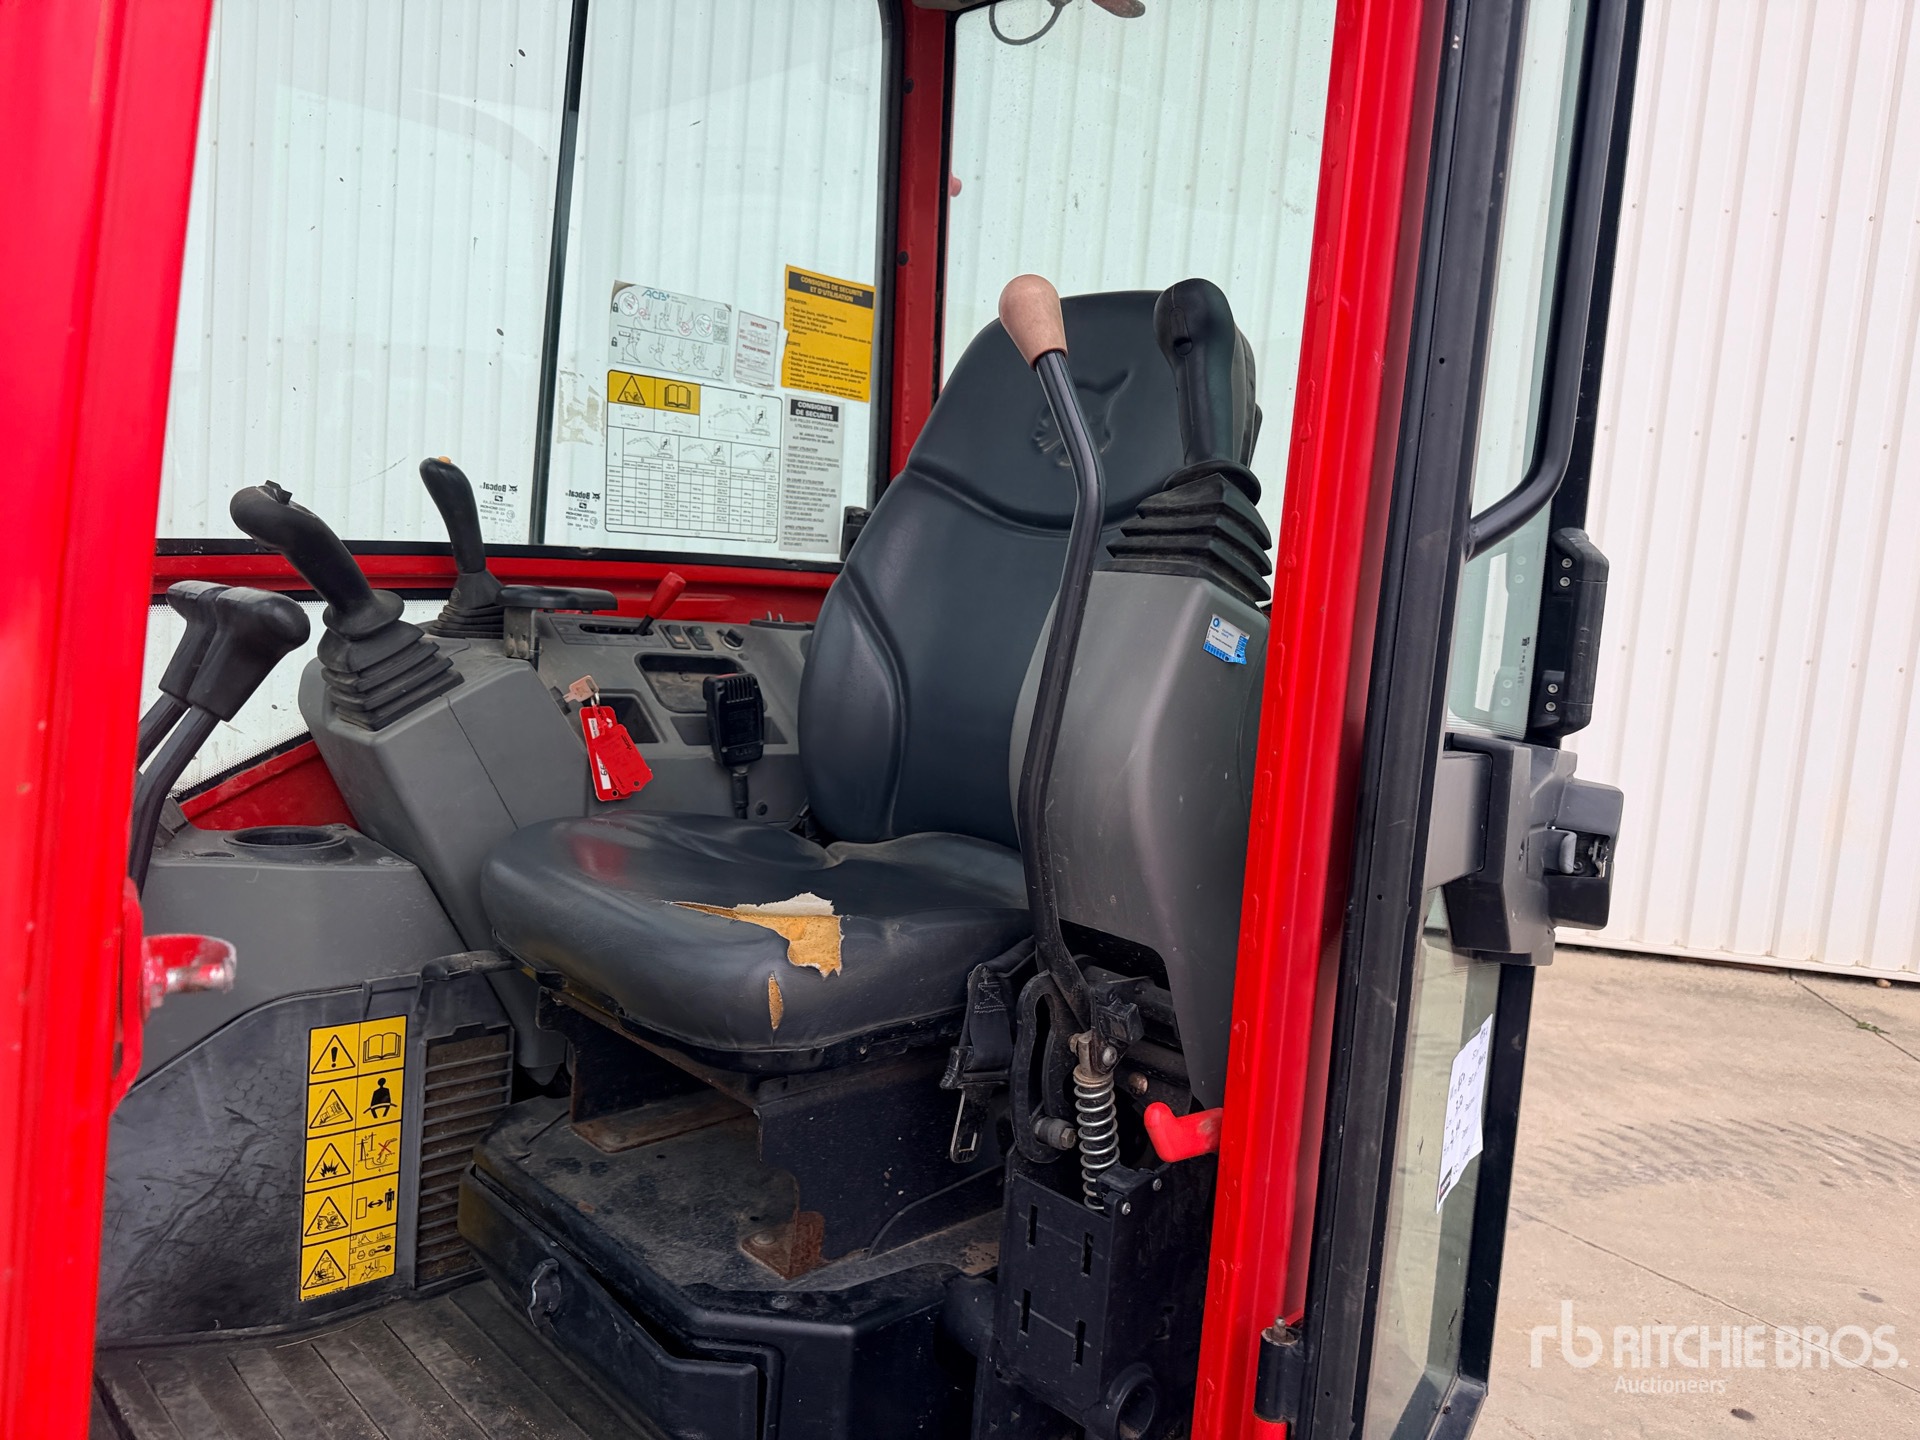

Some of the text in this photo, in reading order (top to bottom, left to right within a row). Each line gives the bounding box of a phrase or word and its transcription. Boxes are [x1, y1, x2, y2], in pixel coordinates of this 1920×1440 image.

[800, 276, 831, 290] CONSIGNES
[831, 283, 838, 292] DE
[809, 286, 854, 303] ET D'UTILISATION
[797, 401, 833, 413] CONSIGNES
